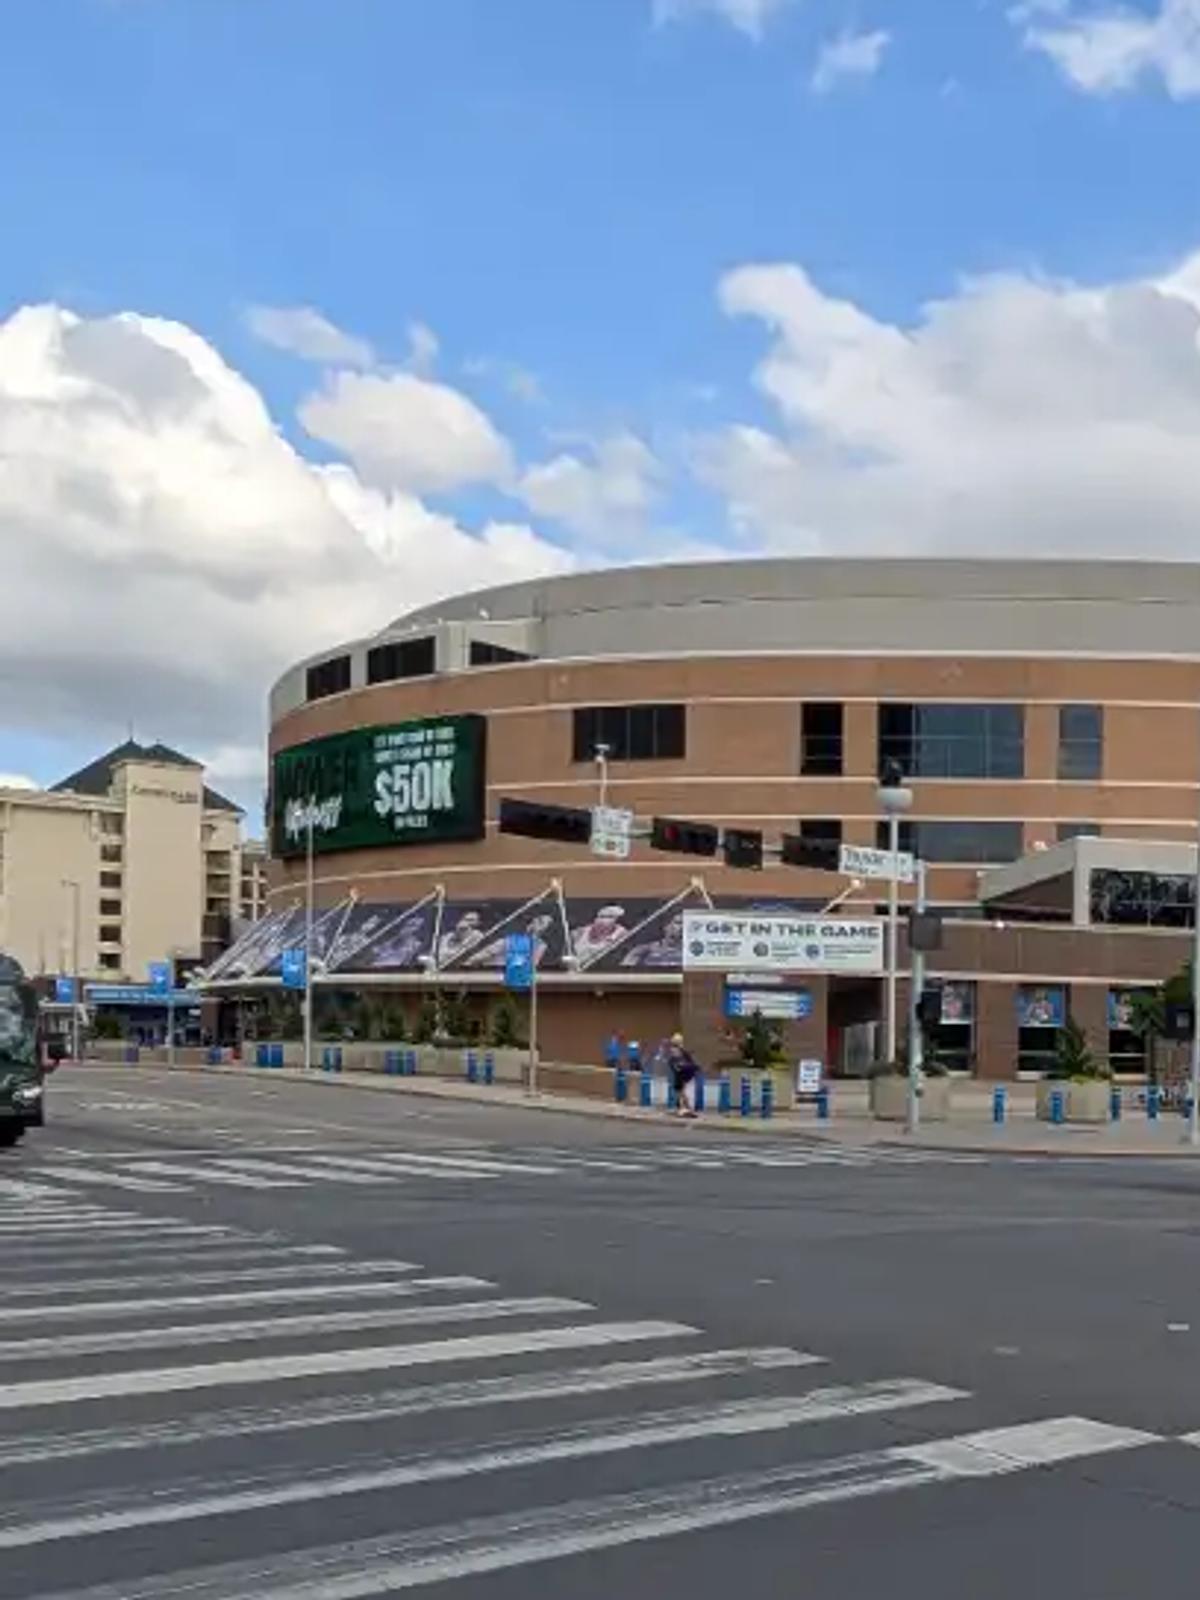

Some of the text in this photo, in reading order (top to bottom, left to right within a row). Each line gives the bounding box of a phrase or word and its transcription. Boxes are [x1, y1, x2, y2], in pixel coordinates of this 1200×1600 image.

[374, 760, 454, 817] $50K
[706, 921, 880, 938] GET IN THE GAME
